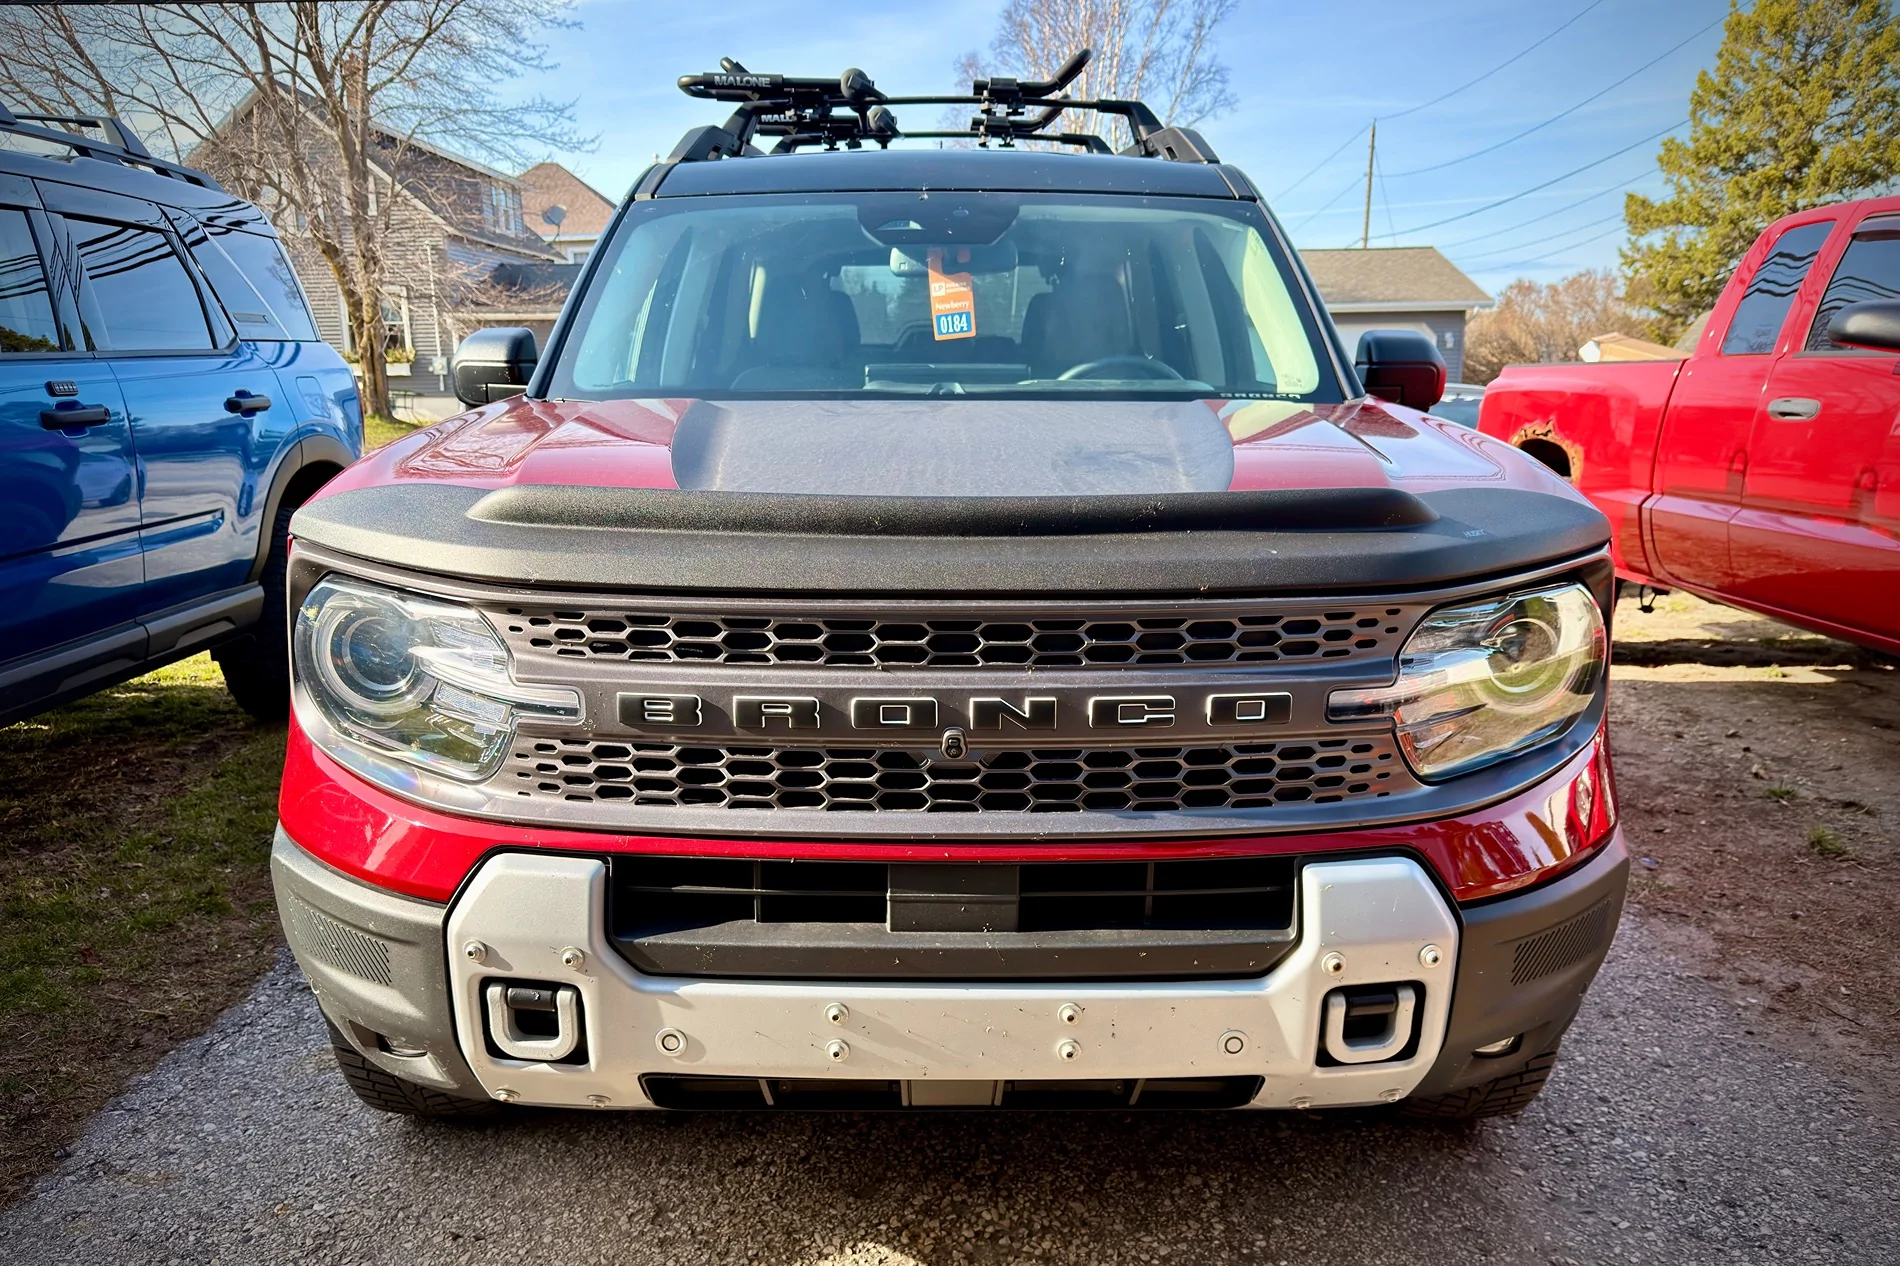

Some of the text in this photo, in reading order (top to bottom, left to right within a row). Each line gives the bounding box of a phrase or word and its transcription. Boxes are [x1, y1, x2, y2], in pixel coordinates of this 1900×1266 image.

[714, 75, 771, 87] MALONE
[935, 300, 970, 310] Newberry
[940, 313, 968, 333] 0184
[616, 691, 1293, 731] BRONCO
